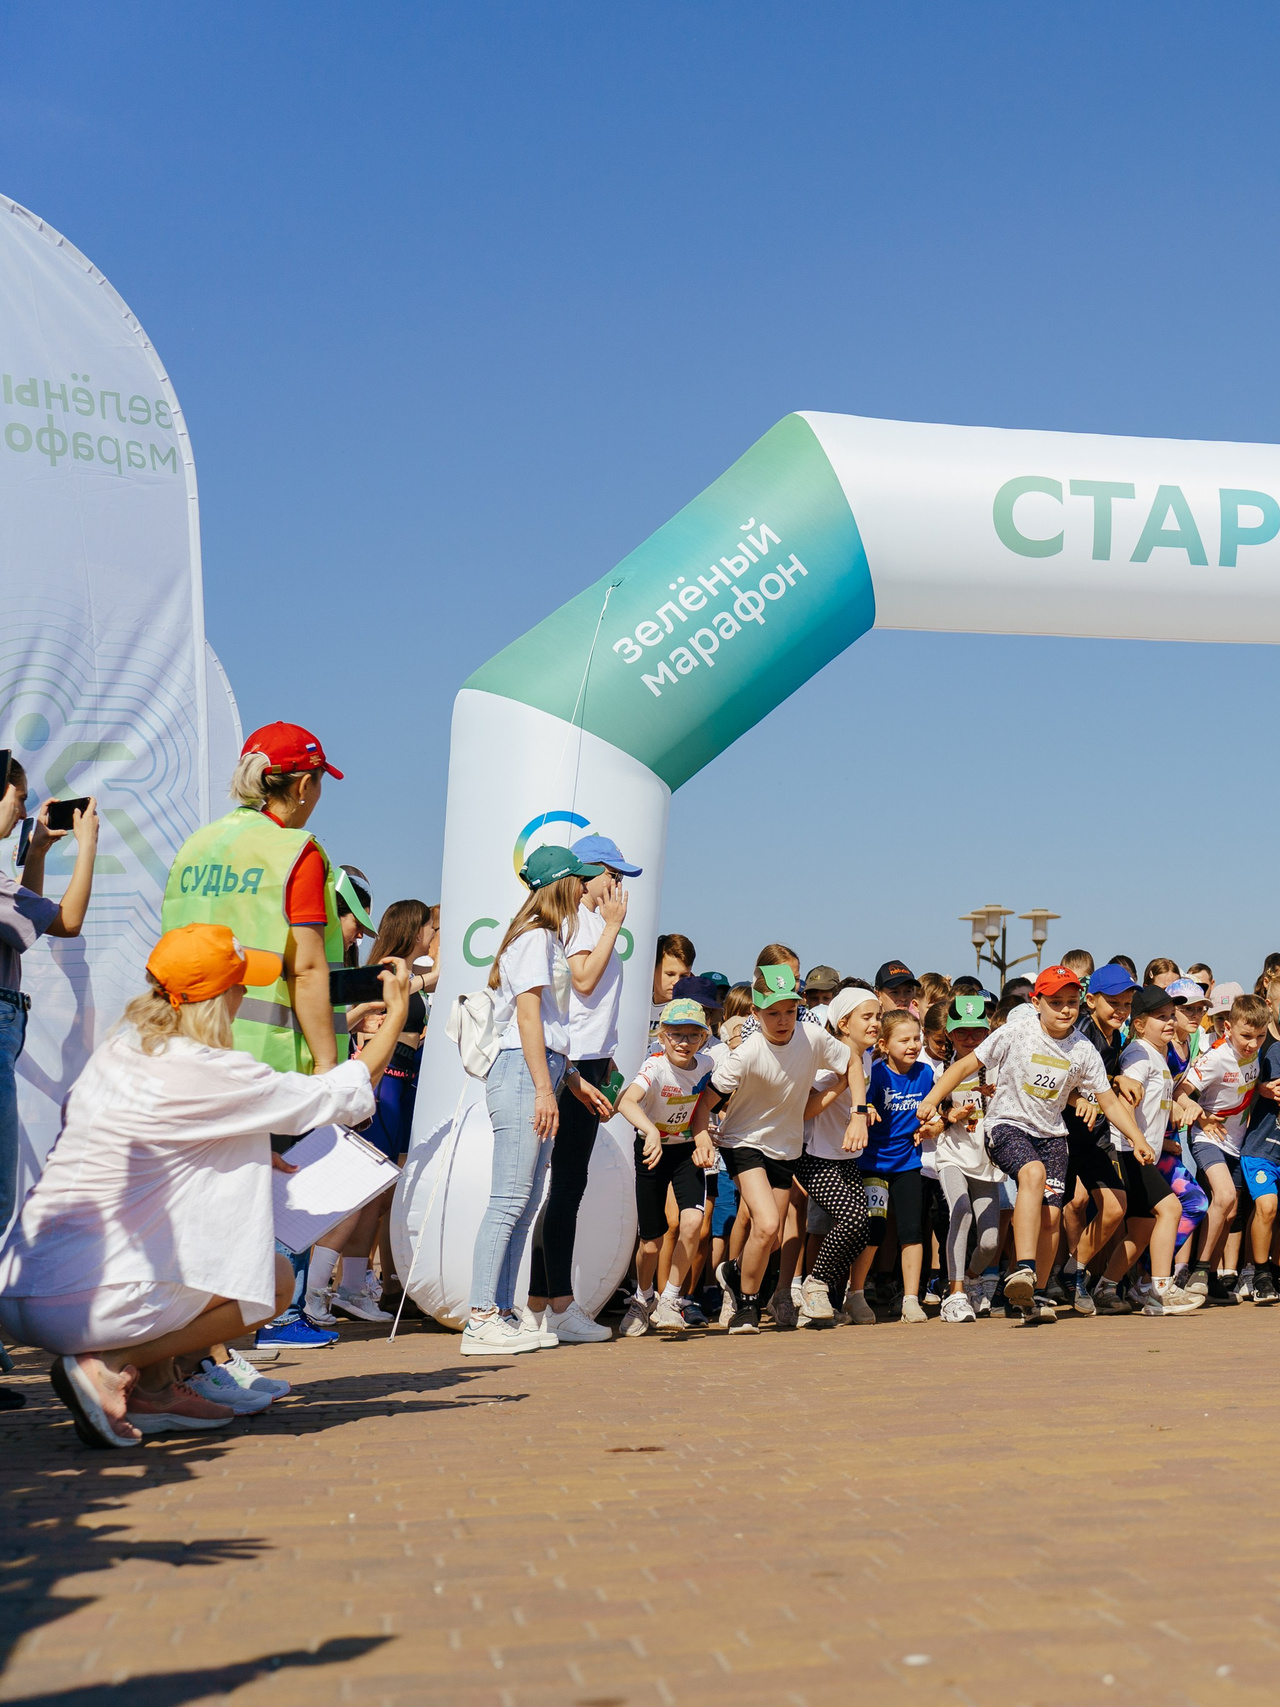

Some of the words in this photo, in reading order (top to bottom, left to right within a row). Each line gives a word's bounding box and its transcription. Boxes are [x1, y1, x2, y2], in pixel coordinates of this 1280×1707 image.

[612, 517, 782, 664] зелёный
[640, 553, 809, 698] марафон
[180, 864, 265, 897] СУДЬЯ
[1034, 1074, 1056, 1089] 226
[667, 1111, 688, 1124] 459
